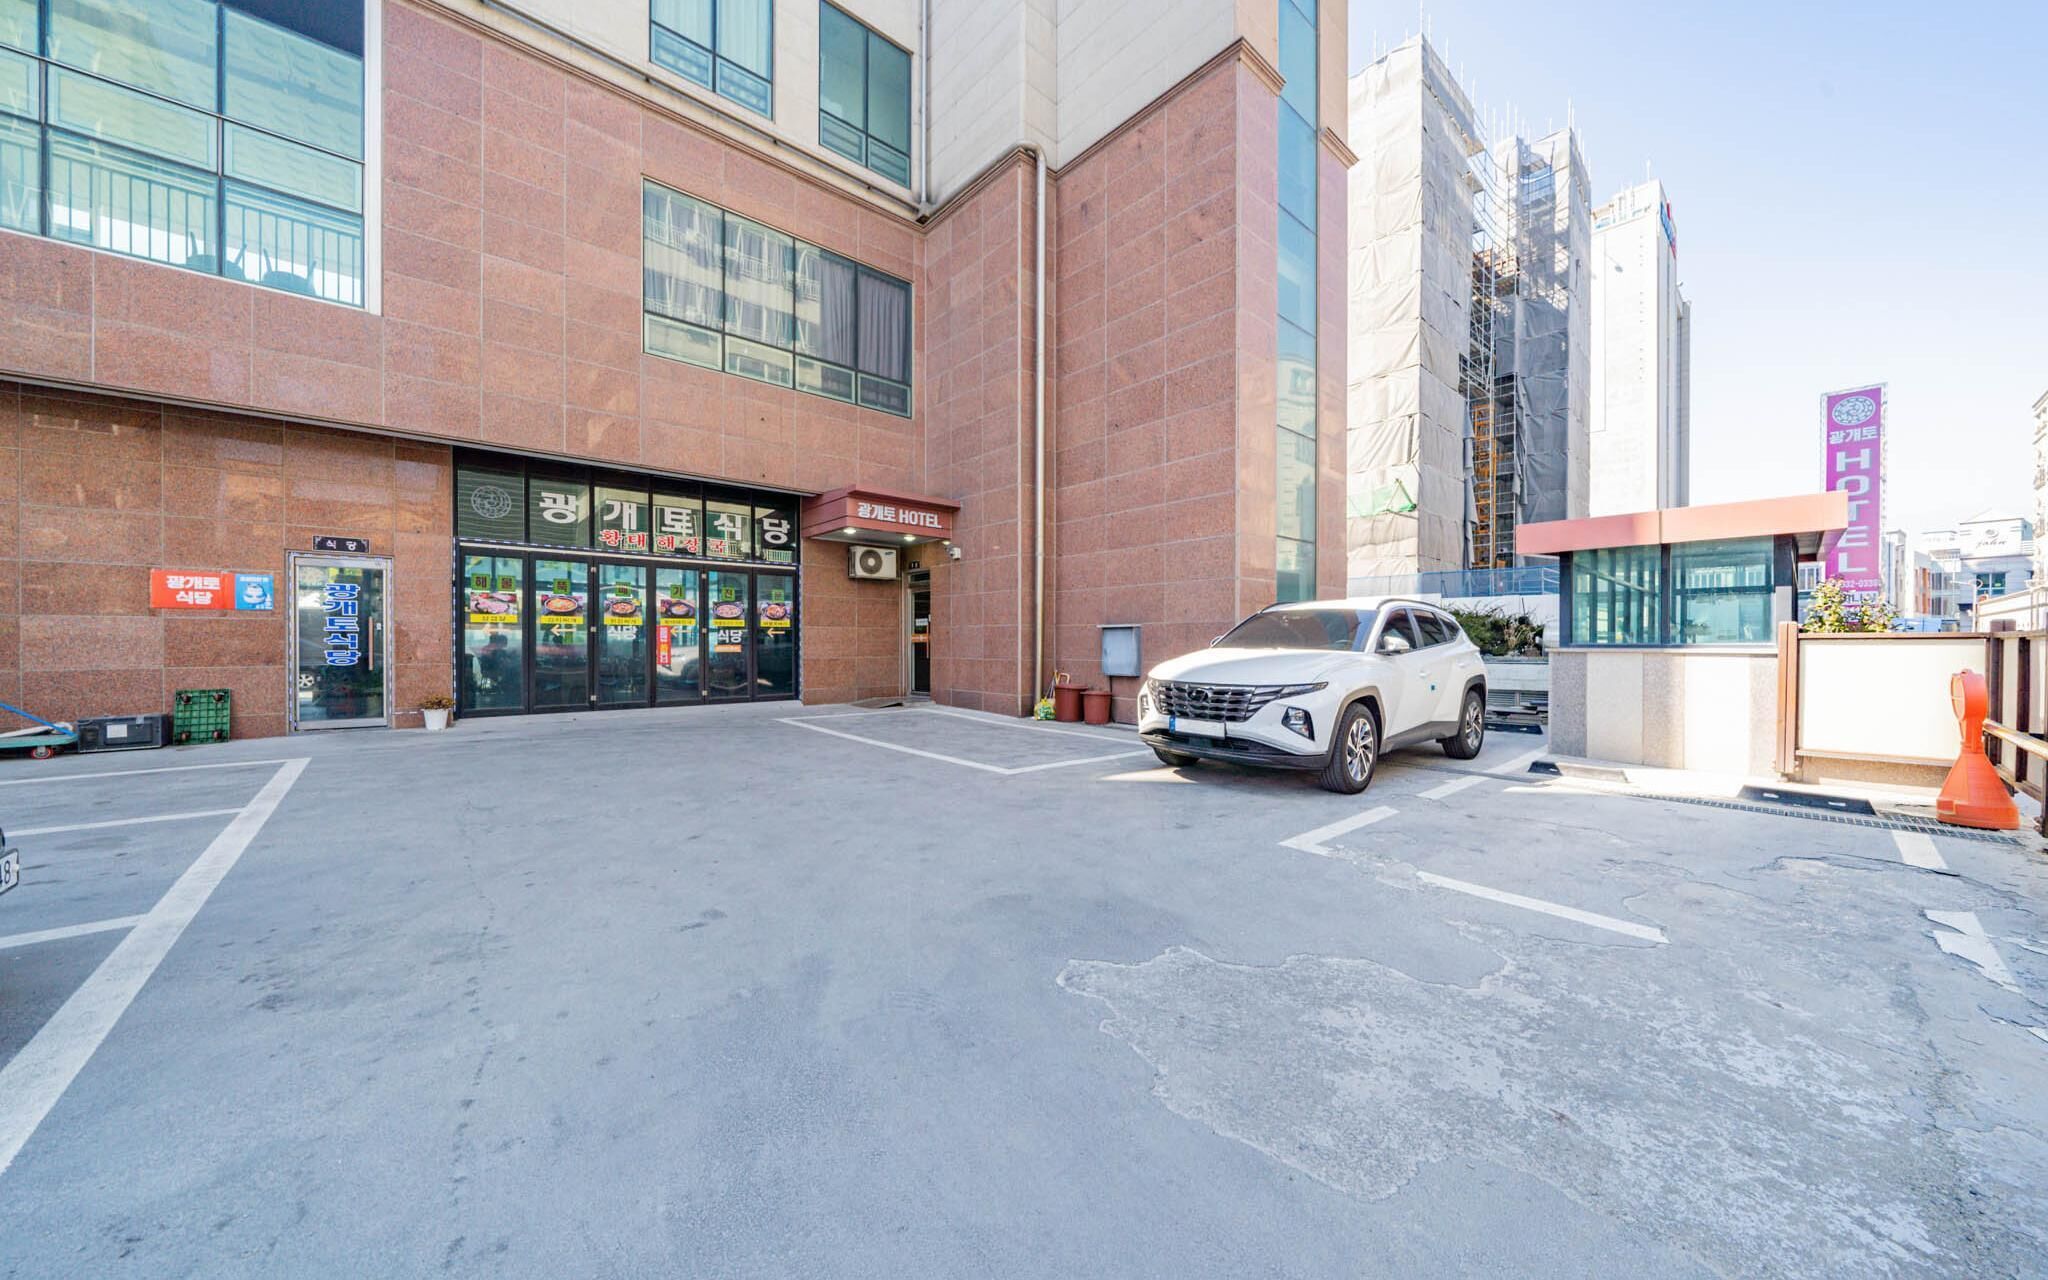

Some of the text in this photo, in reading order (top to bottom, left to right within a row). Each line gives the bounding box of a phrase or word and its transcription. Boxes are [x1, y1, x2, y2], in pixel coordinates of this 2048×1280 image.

[1829, 426, 1878, 445] 광개토
[858, 502, 943, 528] 광개토 HOTEL
[326, 540, 357, 551] 식당
[166, 575, 221, 590] 광개토
[175, 591, 213, 605] 식당
[322, 583, 361, 666] 광개토식당
[718, 629, 742, 643] 식당
